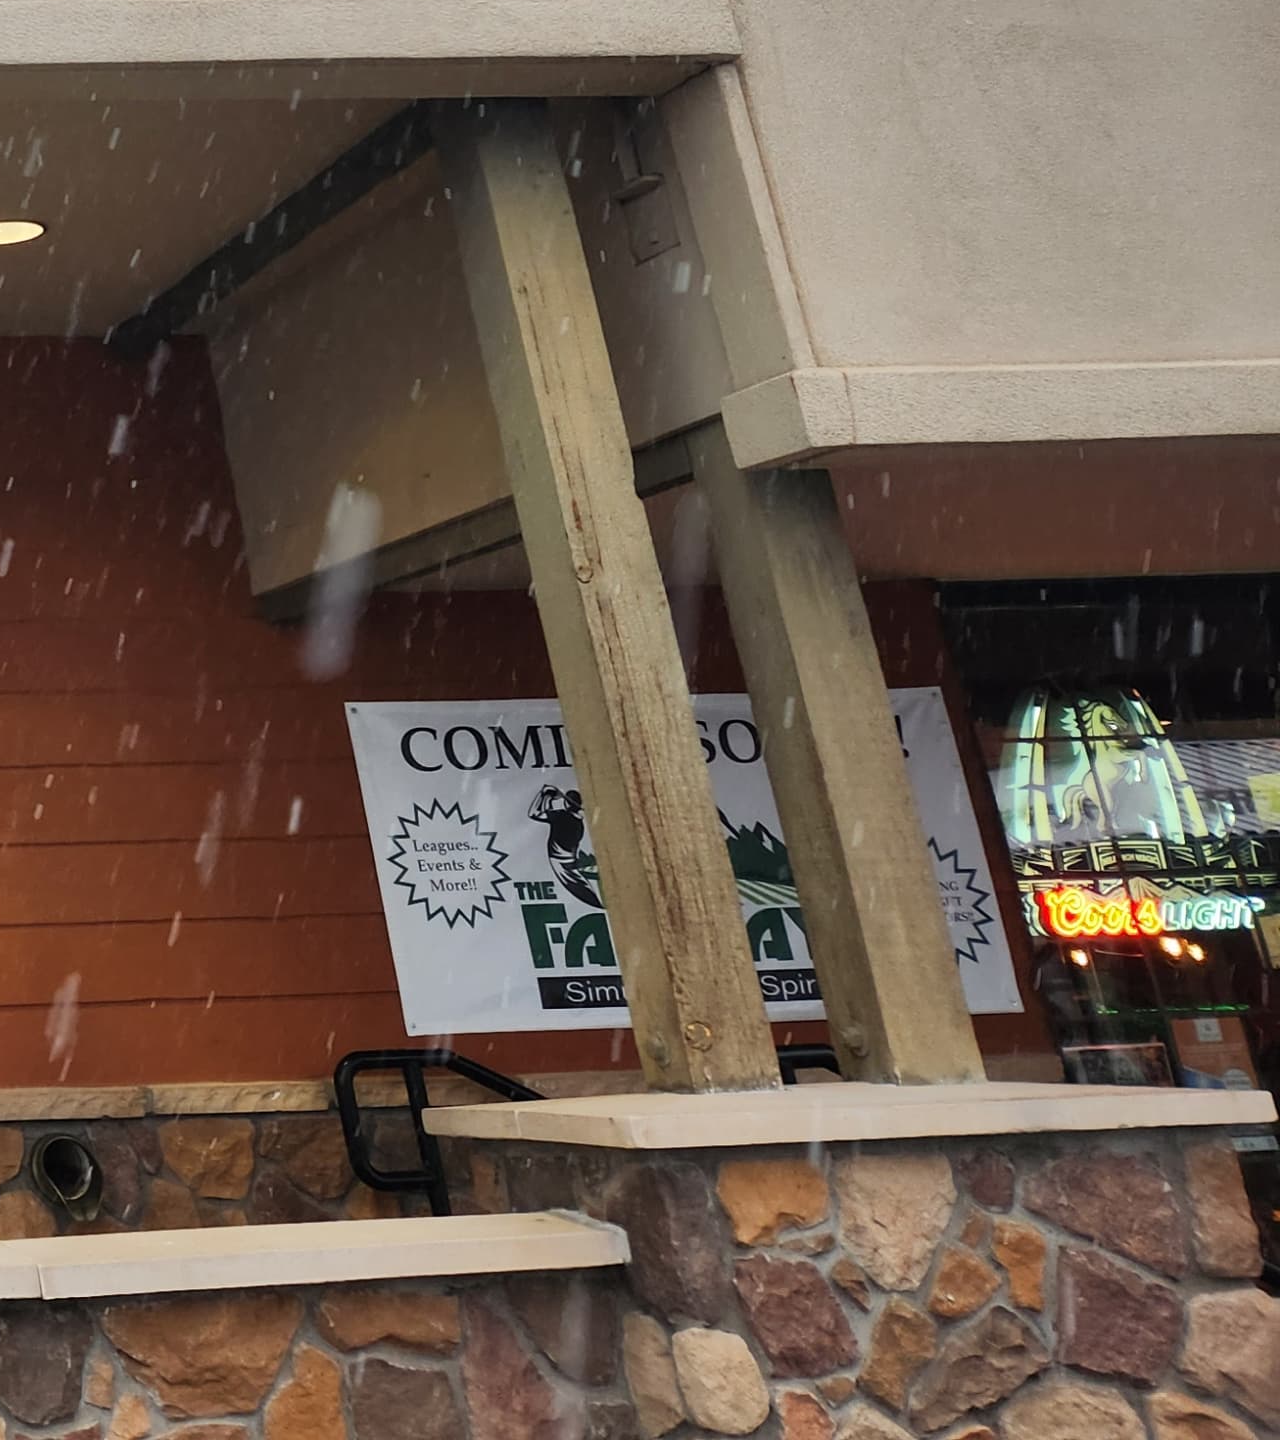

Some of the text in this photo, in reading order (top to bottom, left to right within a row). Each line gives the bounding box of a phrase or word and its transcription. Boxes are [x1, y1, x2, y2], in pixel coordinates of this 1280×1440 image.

[400, 724, 574, 772] COMI
[417, 858, 483, 872] Events &
[429, 878, 478, 892] More!!
[513, 880, 558, 901] THE
[1161, 895, 1266, 931] LIGHT
